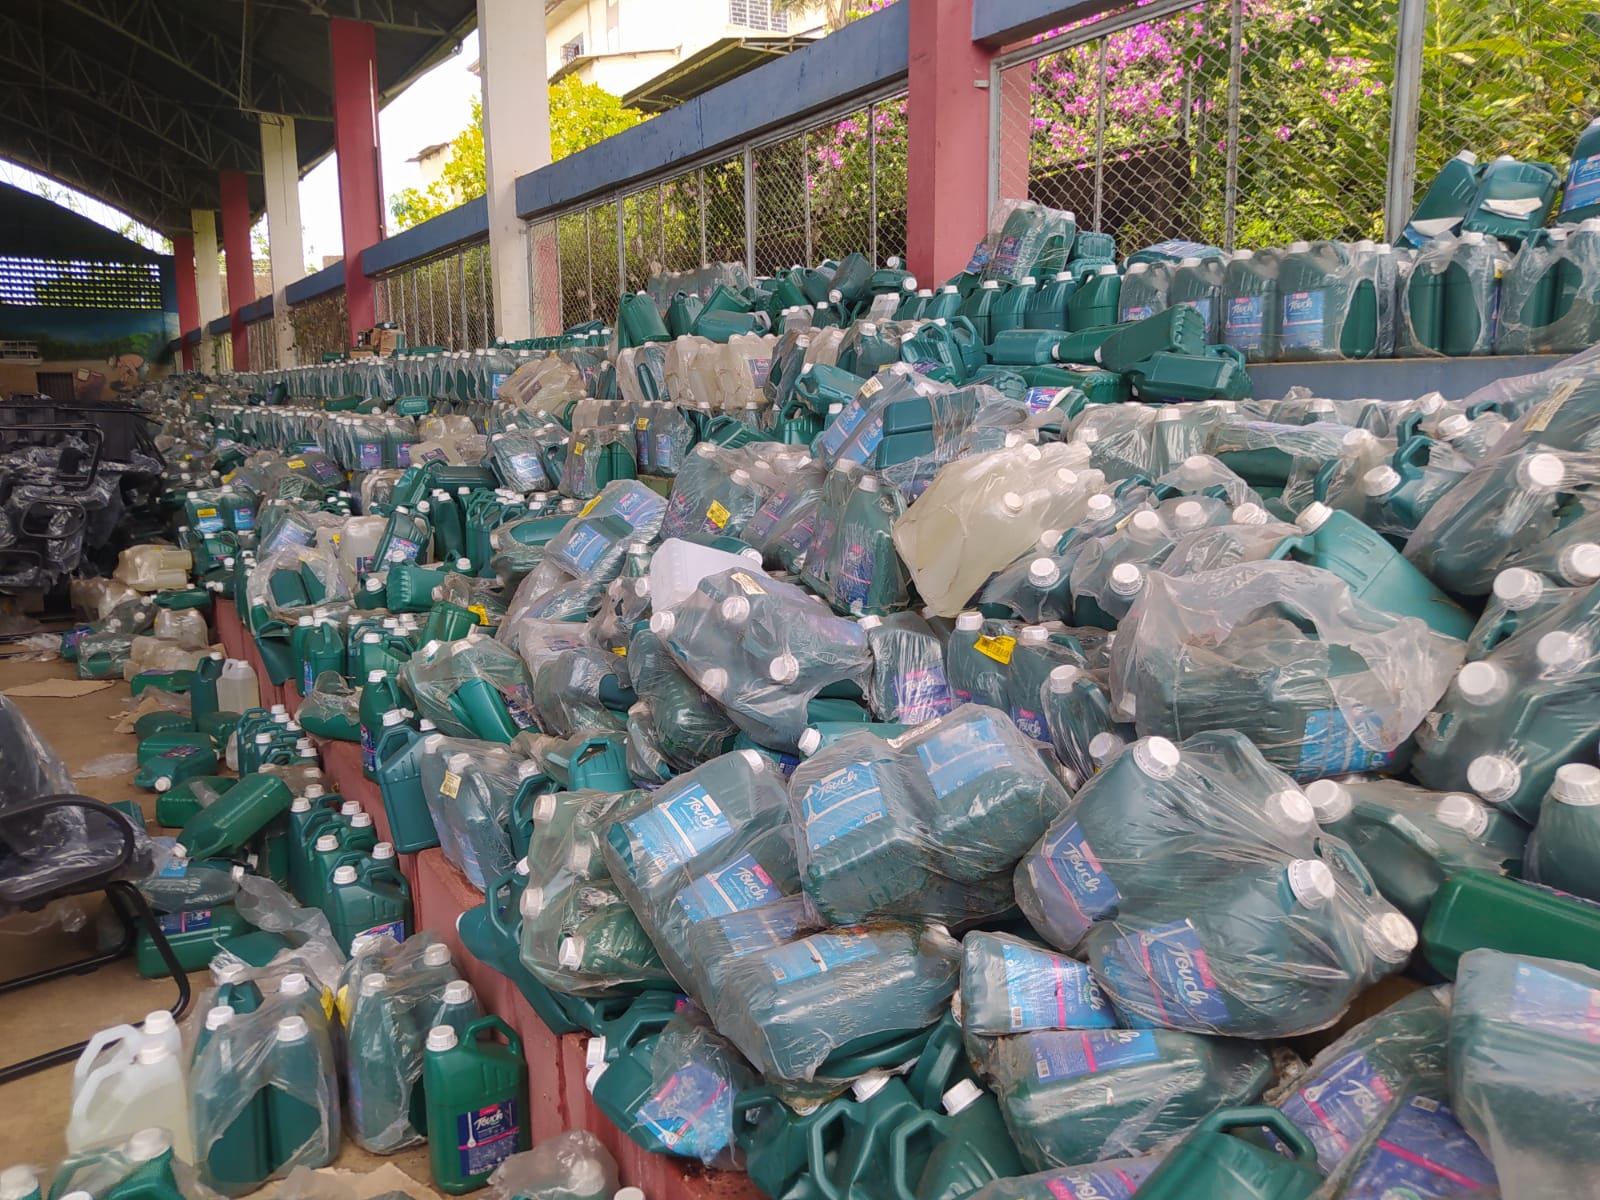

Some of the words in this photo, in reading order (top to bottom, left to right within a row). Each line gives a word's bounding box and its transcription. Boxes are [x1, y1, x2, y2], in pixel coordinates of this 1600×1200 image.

[1016, 718, 1041, 736] Touch
[814, 770, 858, 801] Touch
[683, 796, 718, 830] Touch
[732, 866, 769, 901] Touch
[1062, 841, 1101, 894] Touch
[1167, 942, 1209, 1006] Touch
[474, 1109, 504, 1130] Touch
